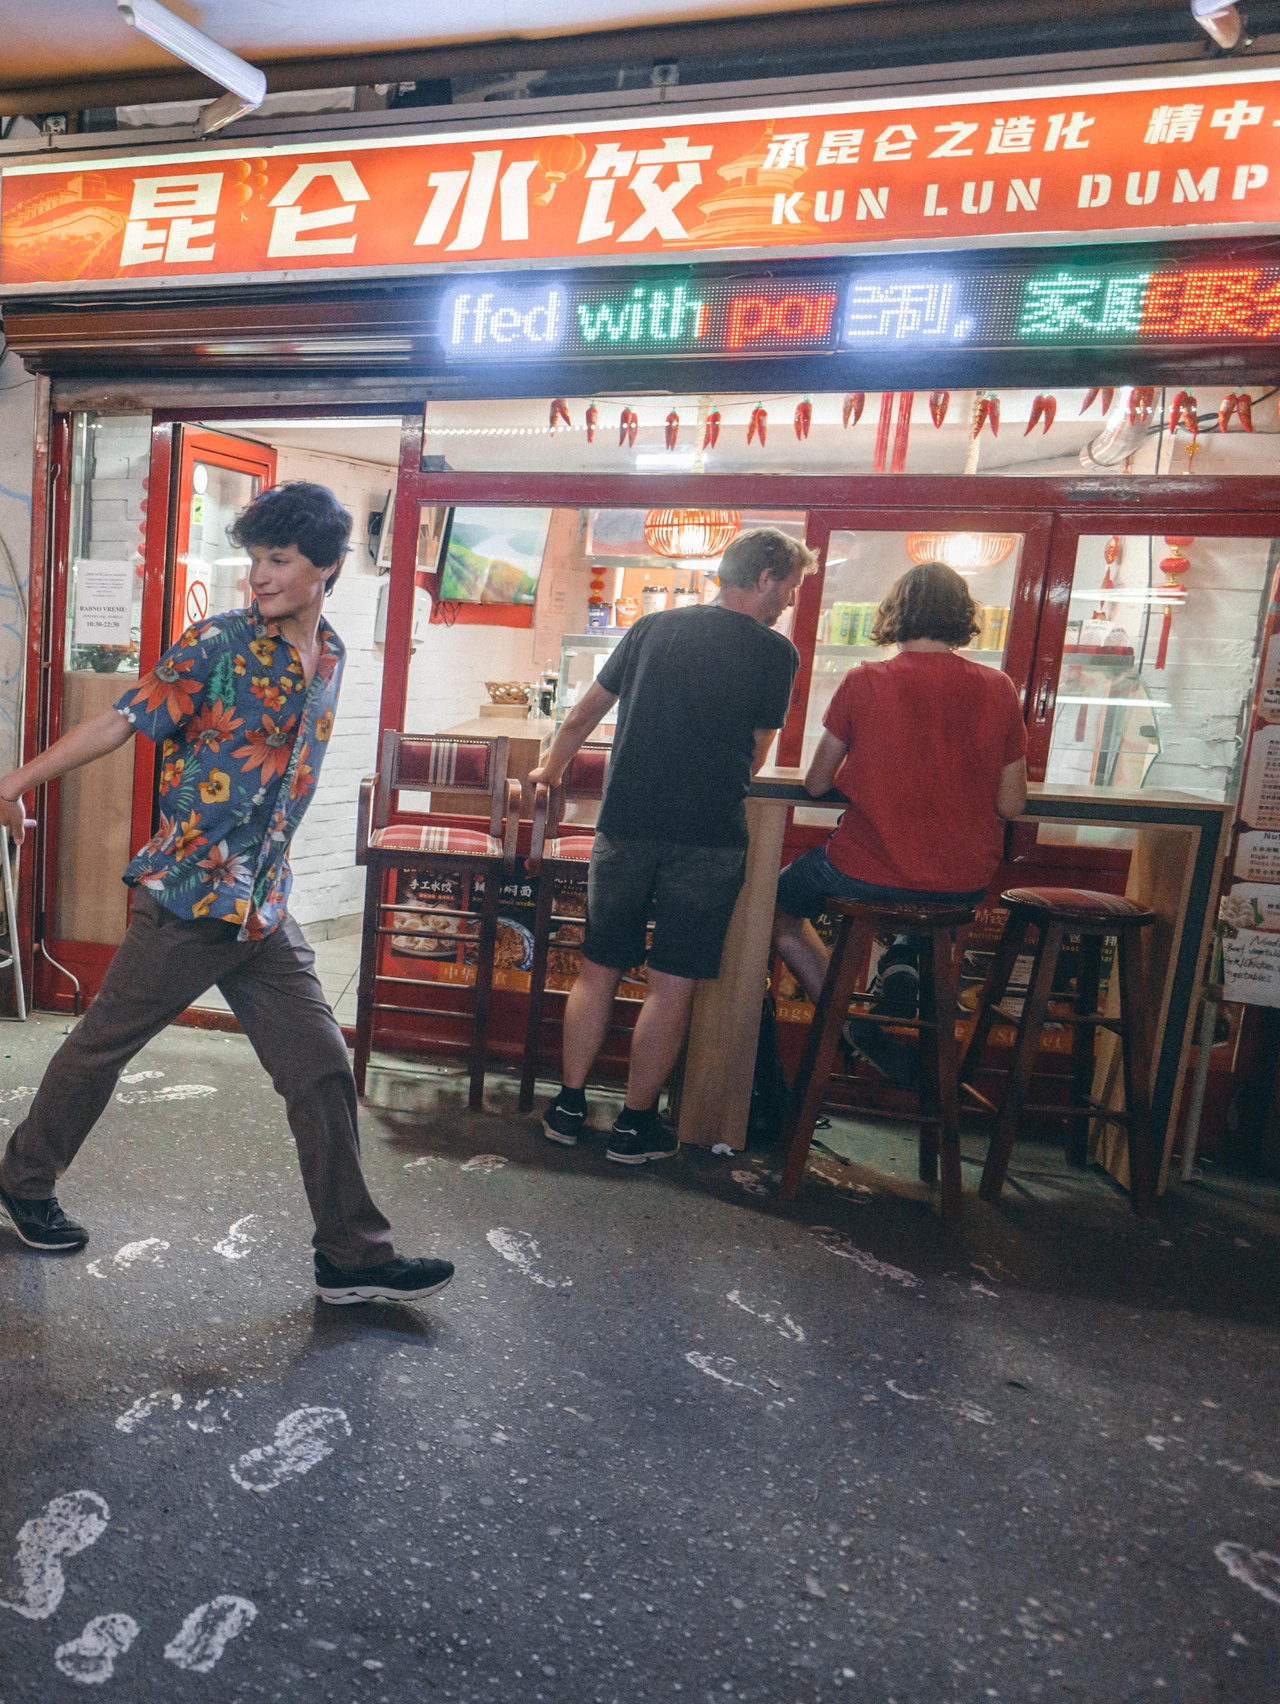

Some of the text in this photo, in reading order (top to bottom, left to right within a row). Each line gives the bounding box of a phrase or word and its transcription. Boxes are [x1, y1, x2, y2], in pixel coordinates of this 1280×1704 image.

[762, 100, 1280, 170] 承昆仑之造化 精中
[120, 136, 714, 267] 昆仑水饺
[771, 164, 1269, 226] KUN LUN DUMP
[577, 286, 710, 342] with
[409, 879, 454, 894] 手工水饺
